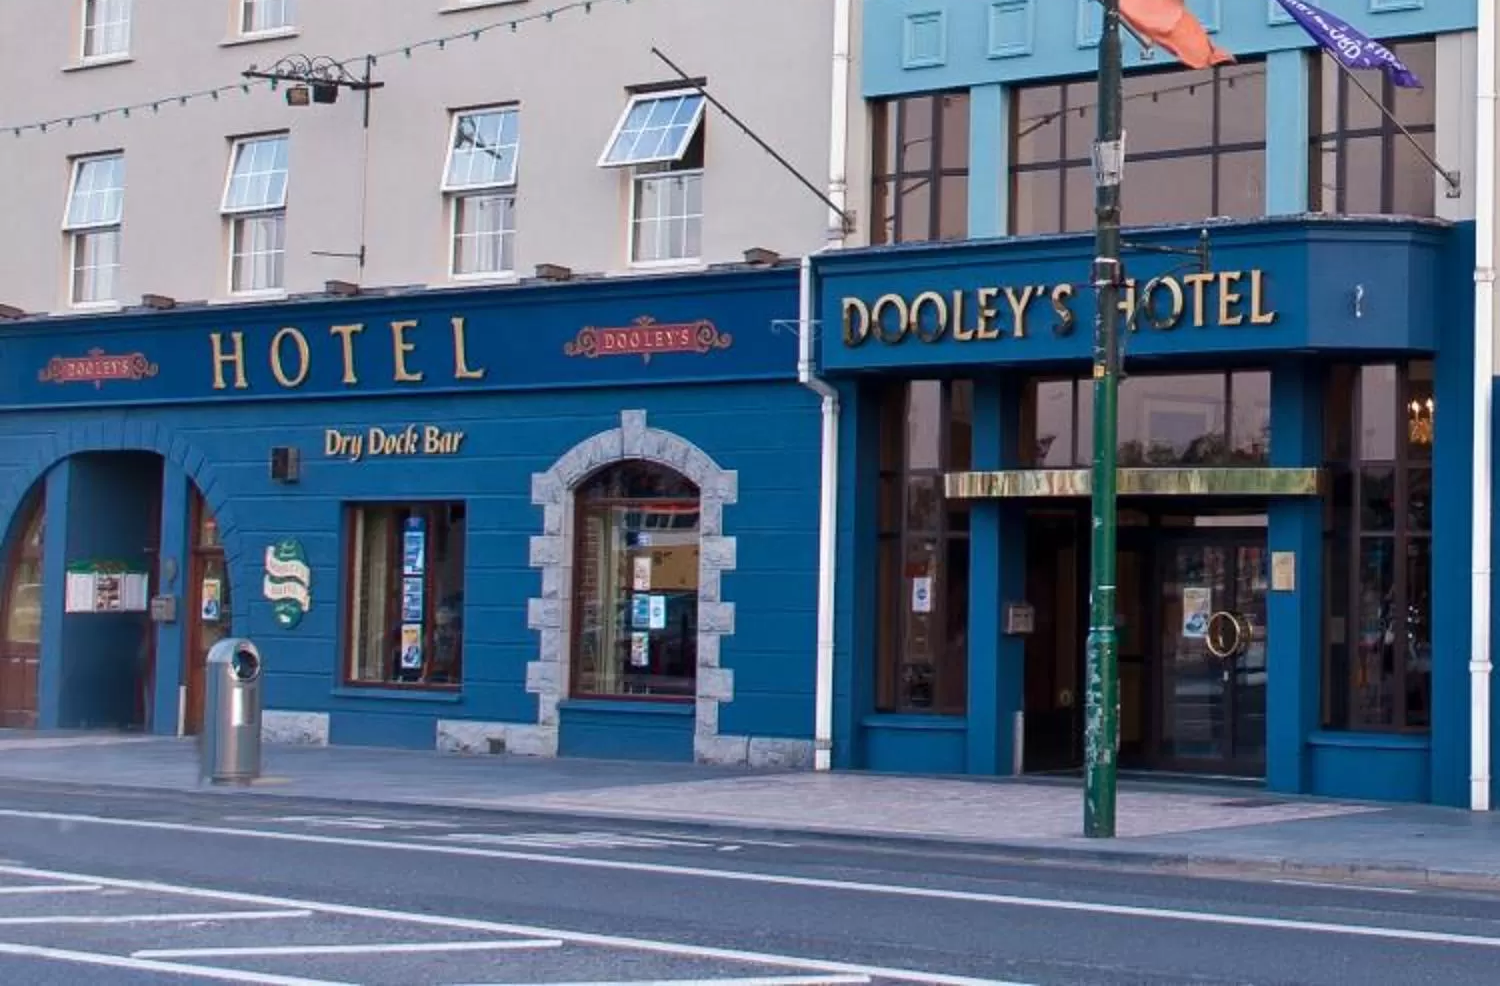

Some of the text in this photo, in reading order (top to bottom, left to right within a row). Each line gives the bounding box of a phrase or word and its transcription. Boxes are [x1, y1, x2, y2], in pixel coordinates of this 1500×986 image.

[604, 329, 690, 349] DOOLEY'S
[841, 283, 1074, 347] DOOLEY'S
[208, 316, 486, 390] HOTEL
[324, 423, 465, 462] Dry Dock Bar
